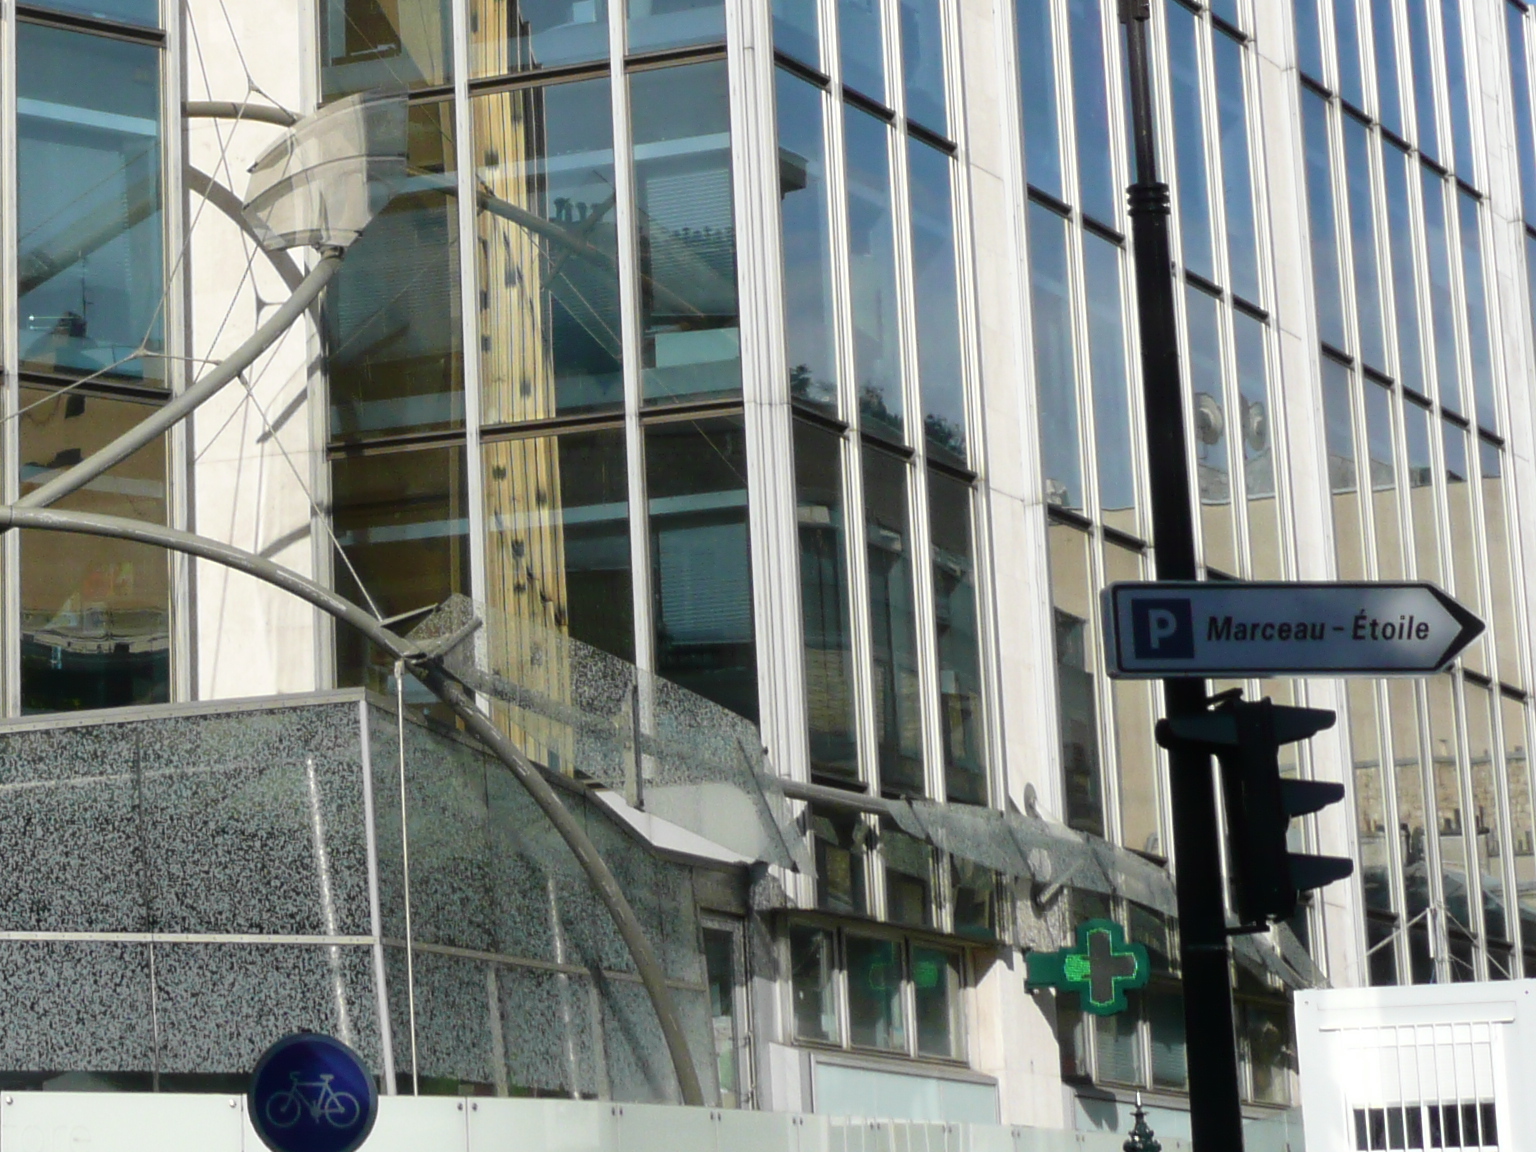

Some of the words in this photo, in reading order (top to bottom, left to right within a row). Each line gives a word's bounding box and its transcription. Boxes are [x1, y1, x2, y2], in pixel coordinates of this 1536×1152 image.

[1149, 608, 1178, 649] P
[1206, 616, 1325, 642] Marceau
[1351, 609, 1430, 641] Étoile
